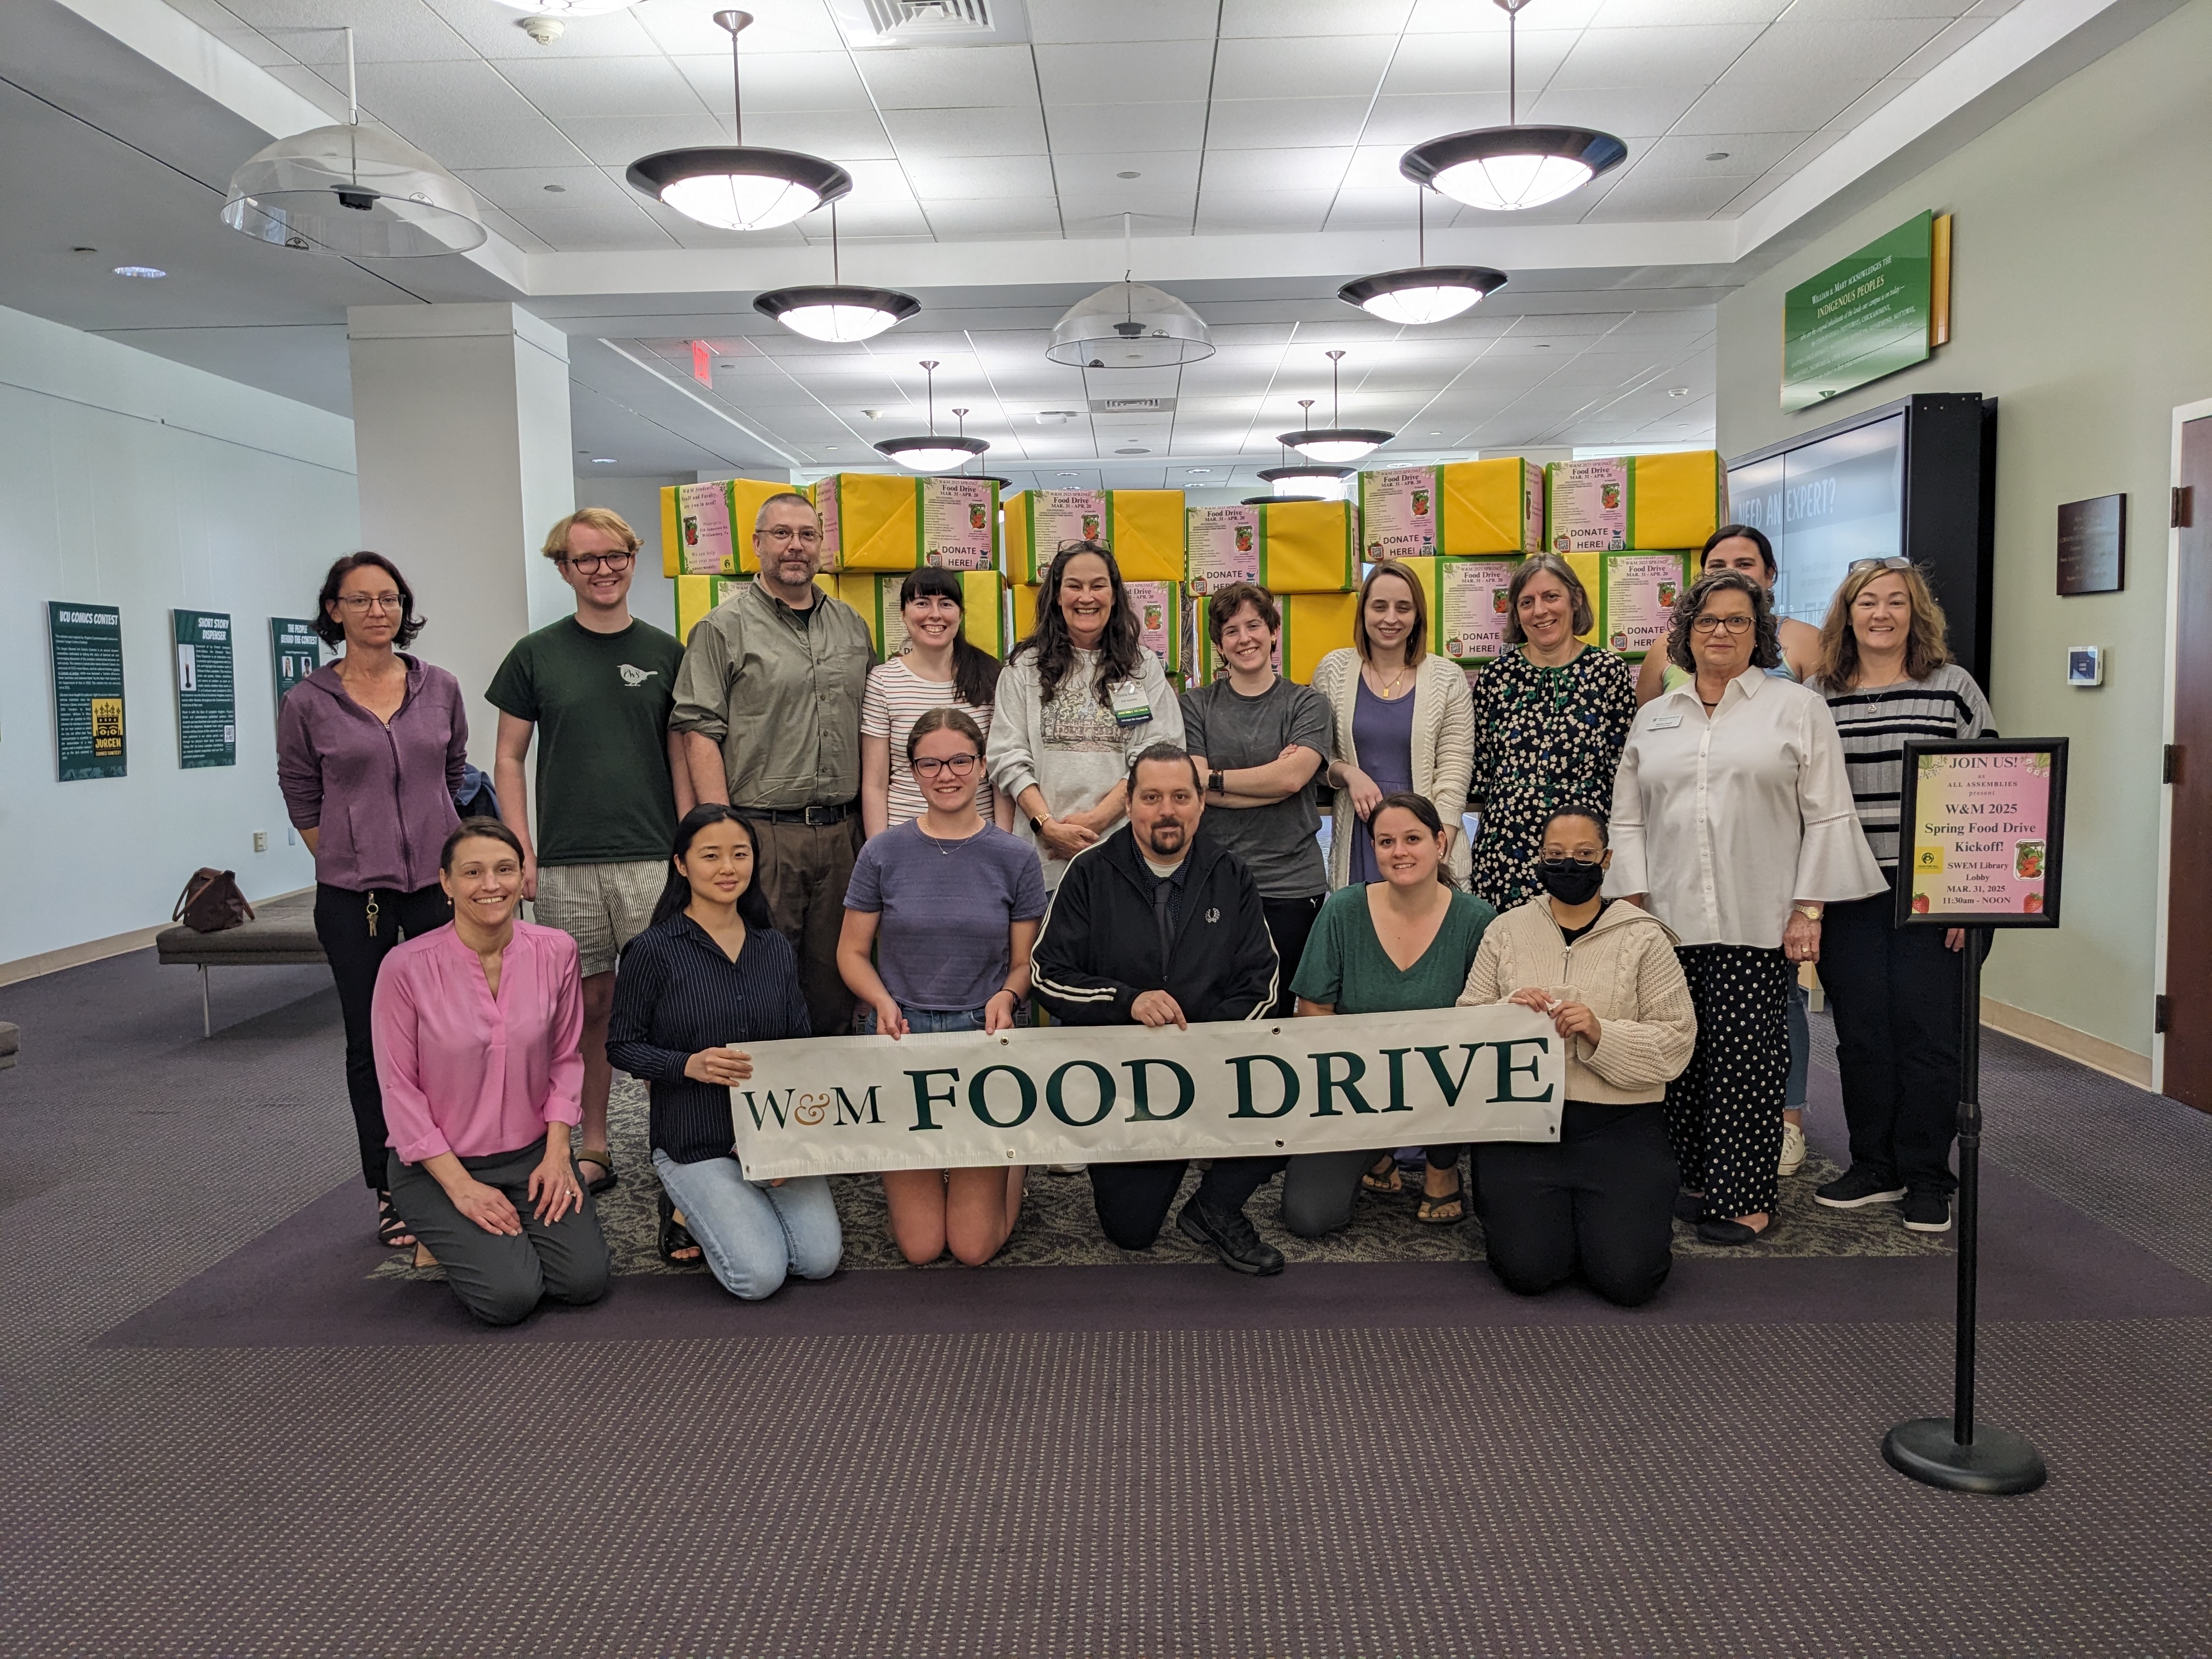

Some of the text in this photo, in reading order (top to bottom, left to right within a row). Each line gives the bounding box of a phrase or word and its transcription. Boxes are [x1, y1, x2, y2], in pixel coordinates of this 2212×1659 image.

[1835, 280, 1847, 293] MARY
[1883, 256, 1892, 267] THE
[1818, 274, 1884, 318] INDIGENOUS PEOPLES
[1739, 477, 1836, 529] NEED AN EXPERT?
[1571, 528, 1608, 537] DONATE
[1384, 534, 1419, 544] DONATE
[1390, 548, 1414, 556] HERE!
[60, 611, 118, 625] VCU COMICS CONTEST
[199, 618, 229, 629] SHORT STORY
[203, 630, 226, 640] DISPENSER
[302, 635, 317, 645] CONTEST
[95, 737, 121, 748] JURGEN
[1949, 757, 2018, 769] JOIN US!
[1945, 804, 2017, 814] W&M 2025
[1925, 822, 2036, 836] Spring Food Drive
[1955, 842, 2004, 851] Kickoff!
[1979, 862, 2008, 870] Library
[741, 1037, 1555, 1131] W&M FOOD DRIVE
